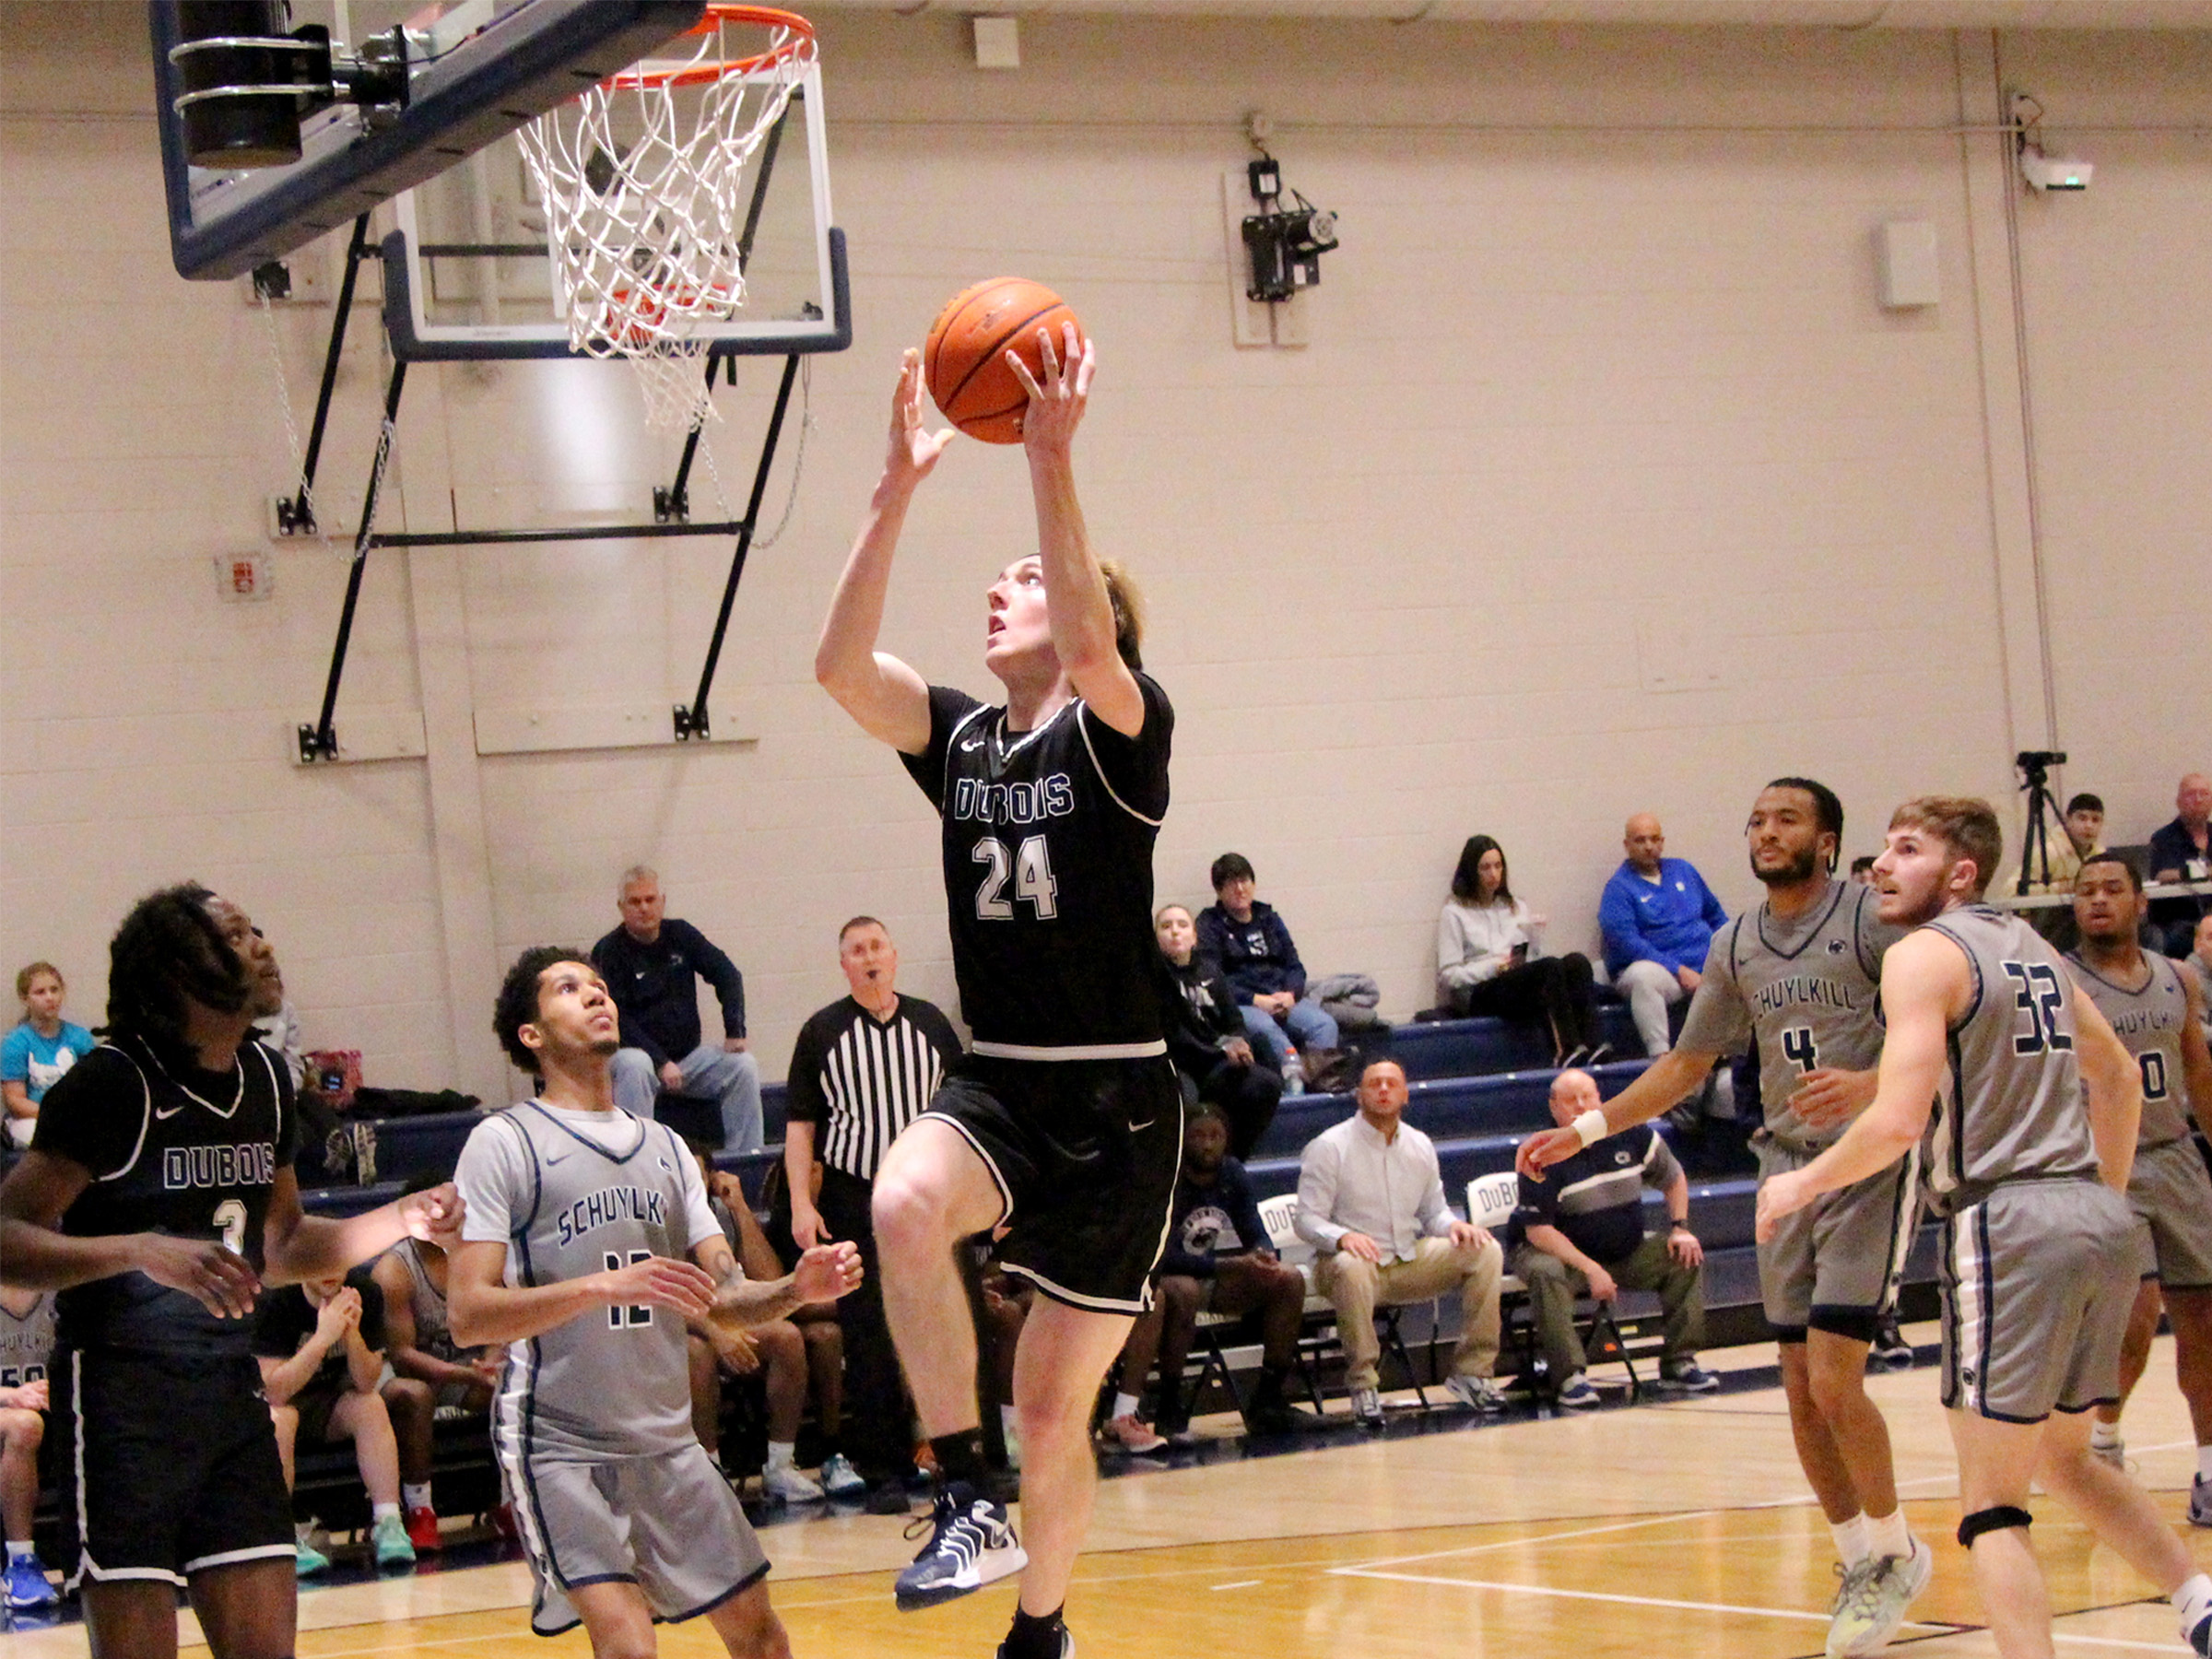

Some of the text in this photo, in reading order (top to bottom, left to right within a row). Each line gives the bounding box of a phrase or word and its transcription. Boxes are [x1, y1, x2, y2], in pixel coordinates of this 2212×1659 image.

[955, 772, 1075, 826] DUBOIS
[972, 834, 1058, 921] 24
[1753, 977, 1858, 1019] HUYLKILL
[2000, 960, 2075, 1057] 32
[1781, 1026, 1818, 1074] 4
[2138, 1049, 2170, 1103] 0
[164, 1142, 276, 1189] DUBOIS
[213, 1199, 248, 1255] 3
[558, 1185, 669, 1249] SCHUYLK
[1265, 1203, 1298, 1233] DuB
